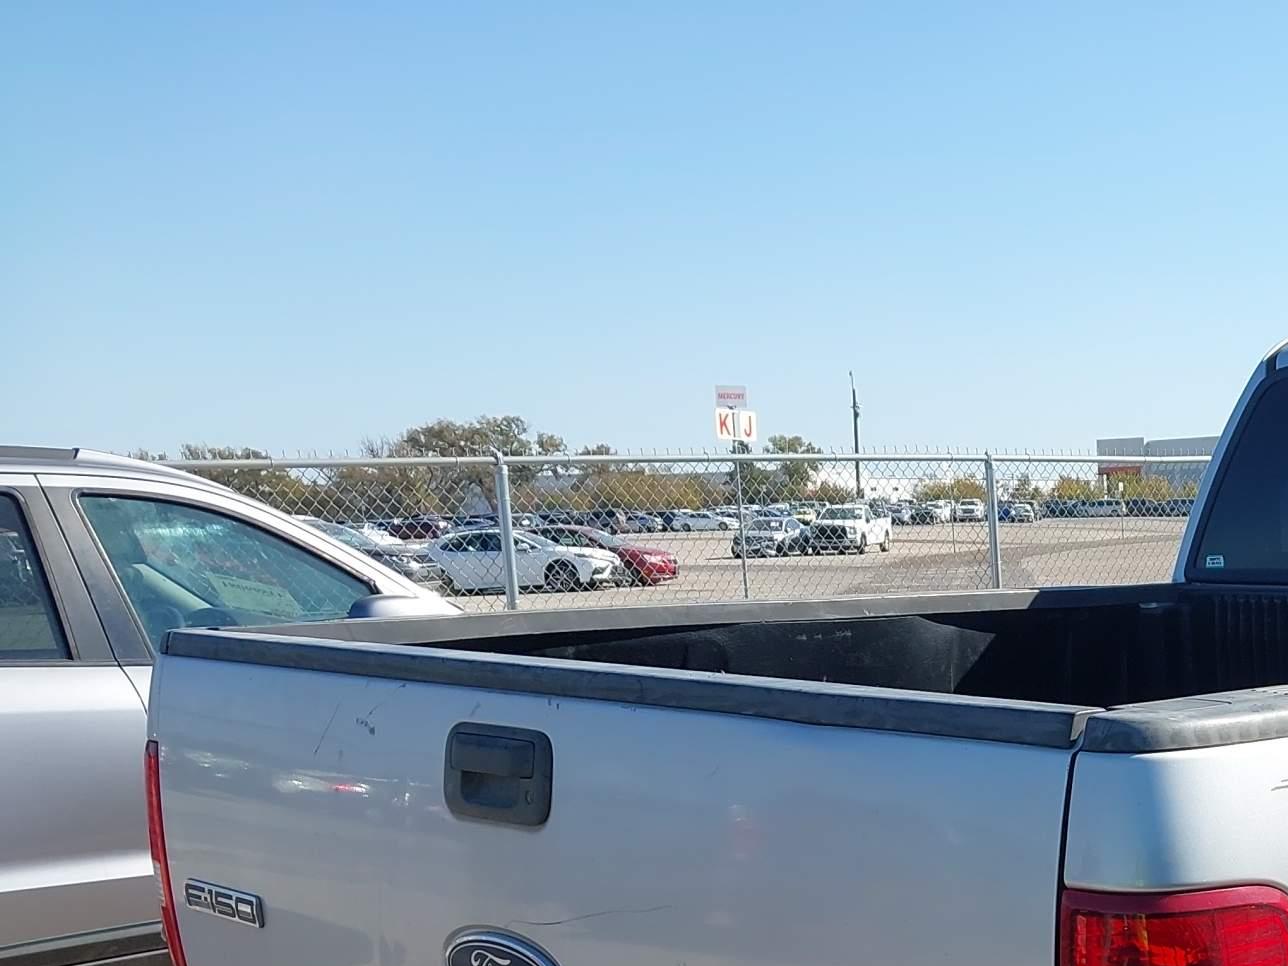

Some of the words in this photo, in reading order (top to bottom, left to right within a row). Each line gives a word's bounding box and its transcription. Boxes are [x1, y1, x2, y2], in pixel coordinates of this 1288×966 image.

[719, 412, 731, 436] K
[744, 415, 752, 438] J
[184, 882, 258, 926] F-150
